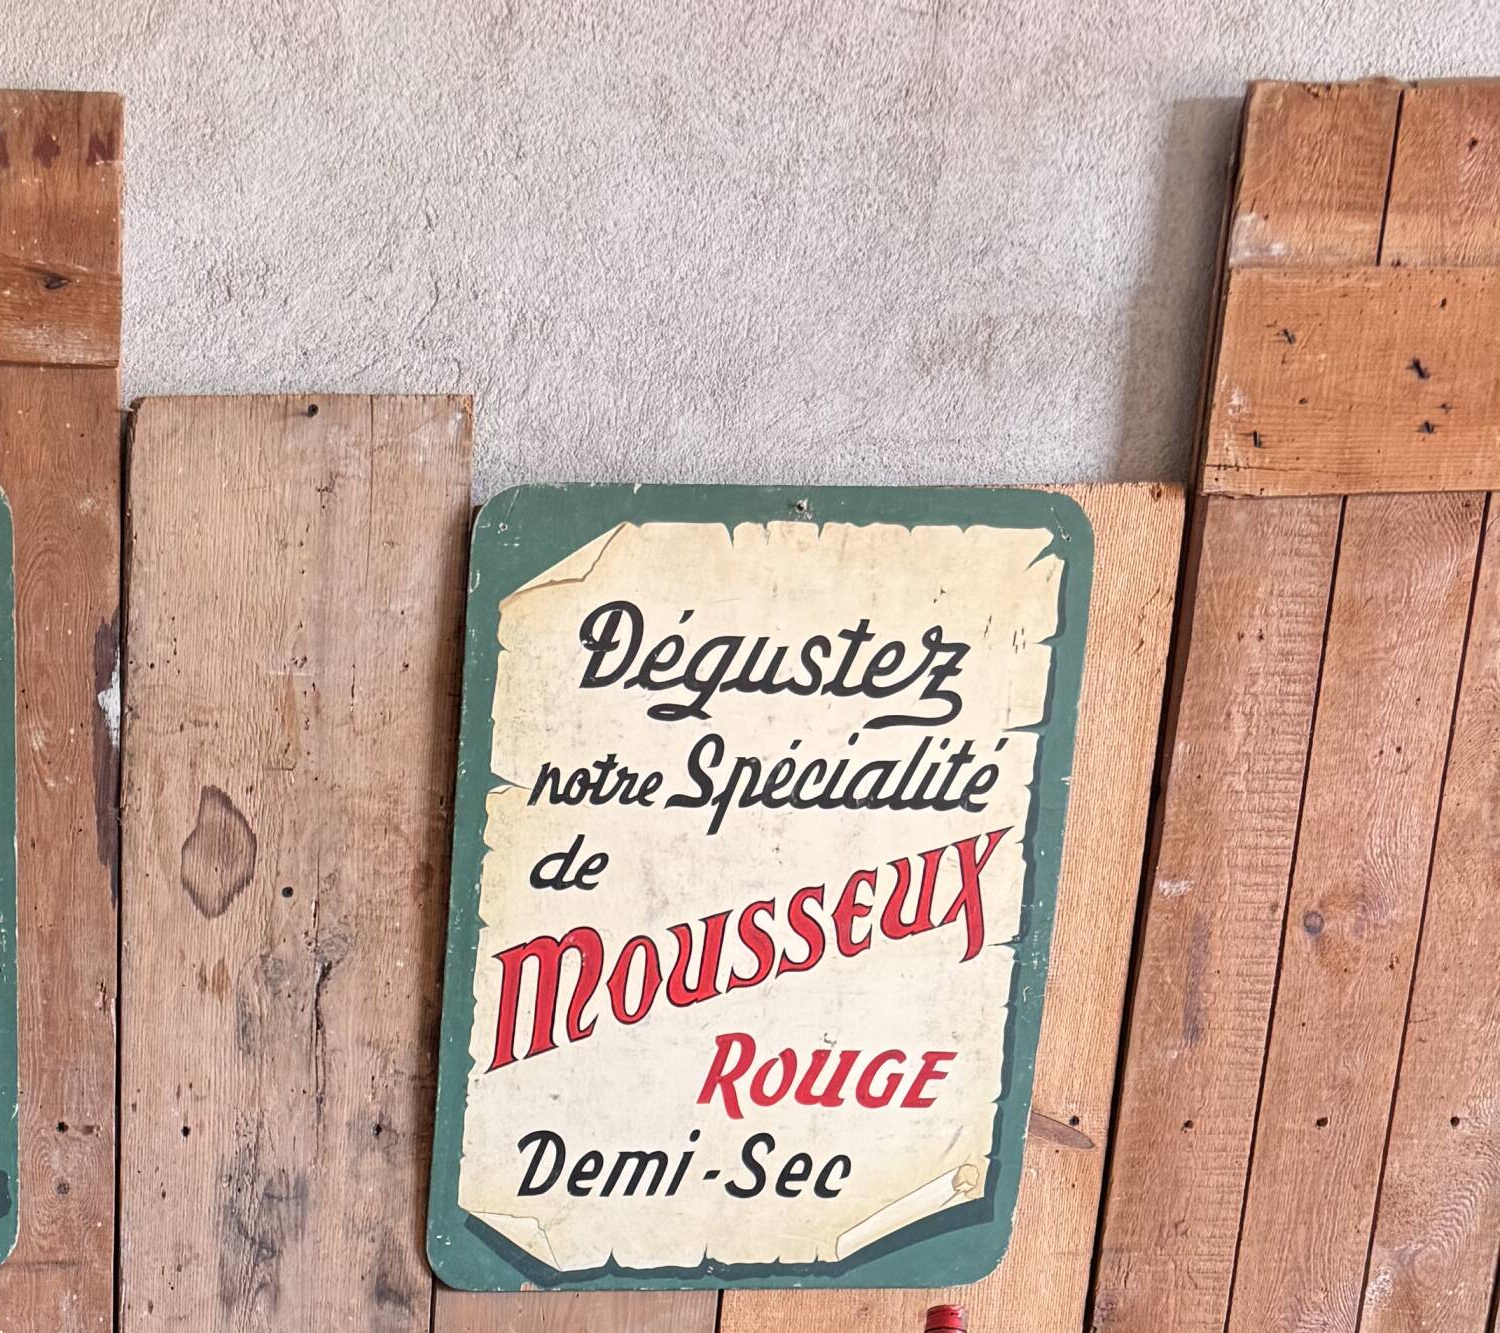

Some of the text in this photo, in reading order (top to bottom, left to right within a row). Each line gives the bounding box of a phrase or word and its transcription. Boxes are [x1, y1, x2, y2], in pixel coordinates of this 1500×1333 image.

[579, 600, 970, 729] Dégustez
[527, 732, 1009, 836] notre Spécialité
[529, 833, 609, 892] de
[487, 826, 1014, 1074] MOUSSEUX
[697, 1032, 957, 1121] ROUGE
[517, 1129, 852, 1199] Demi-Sec
